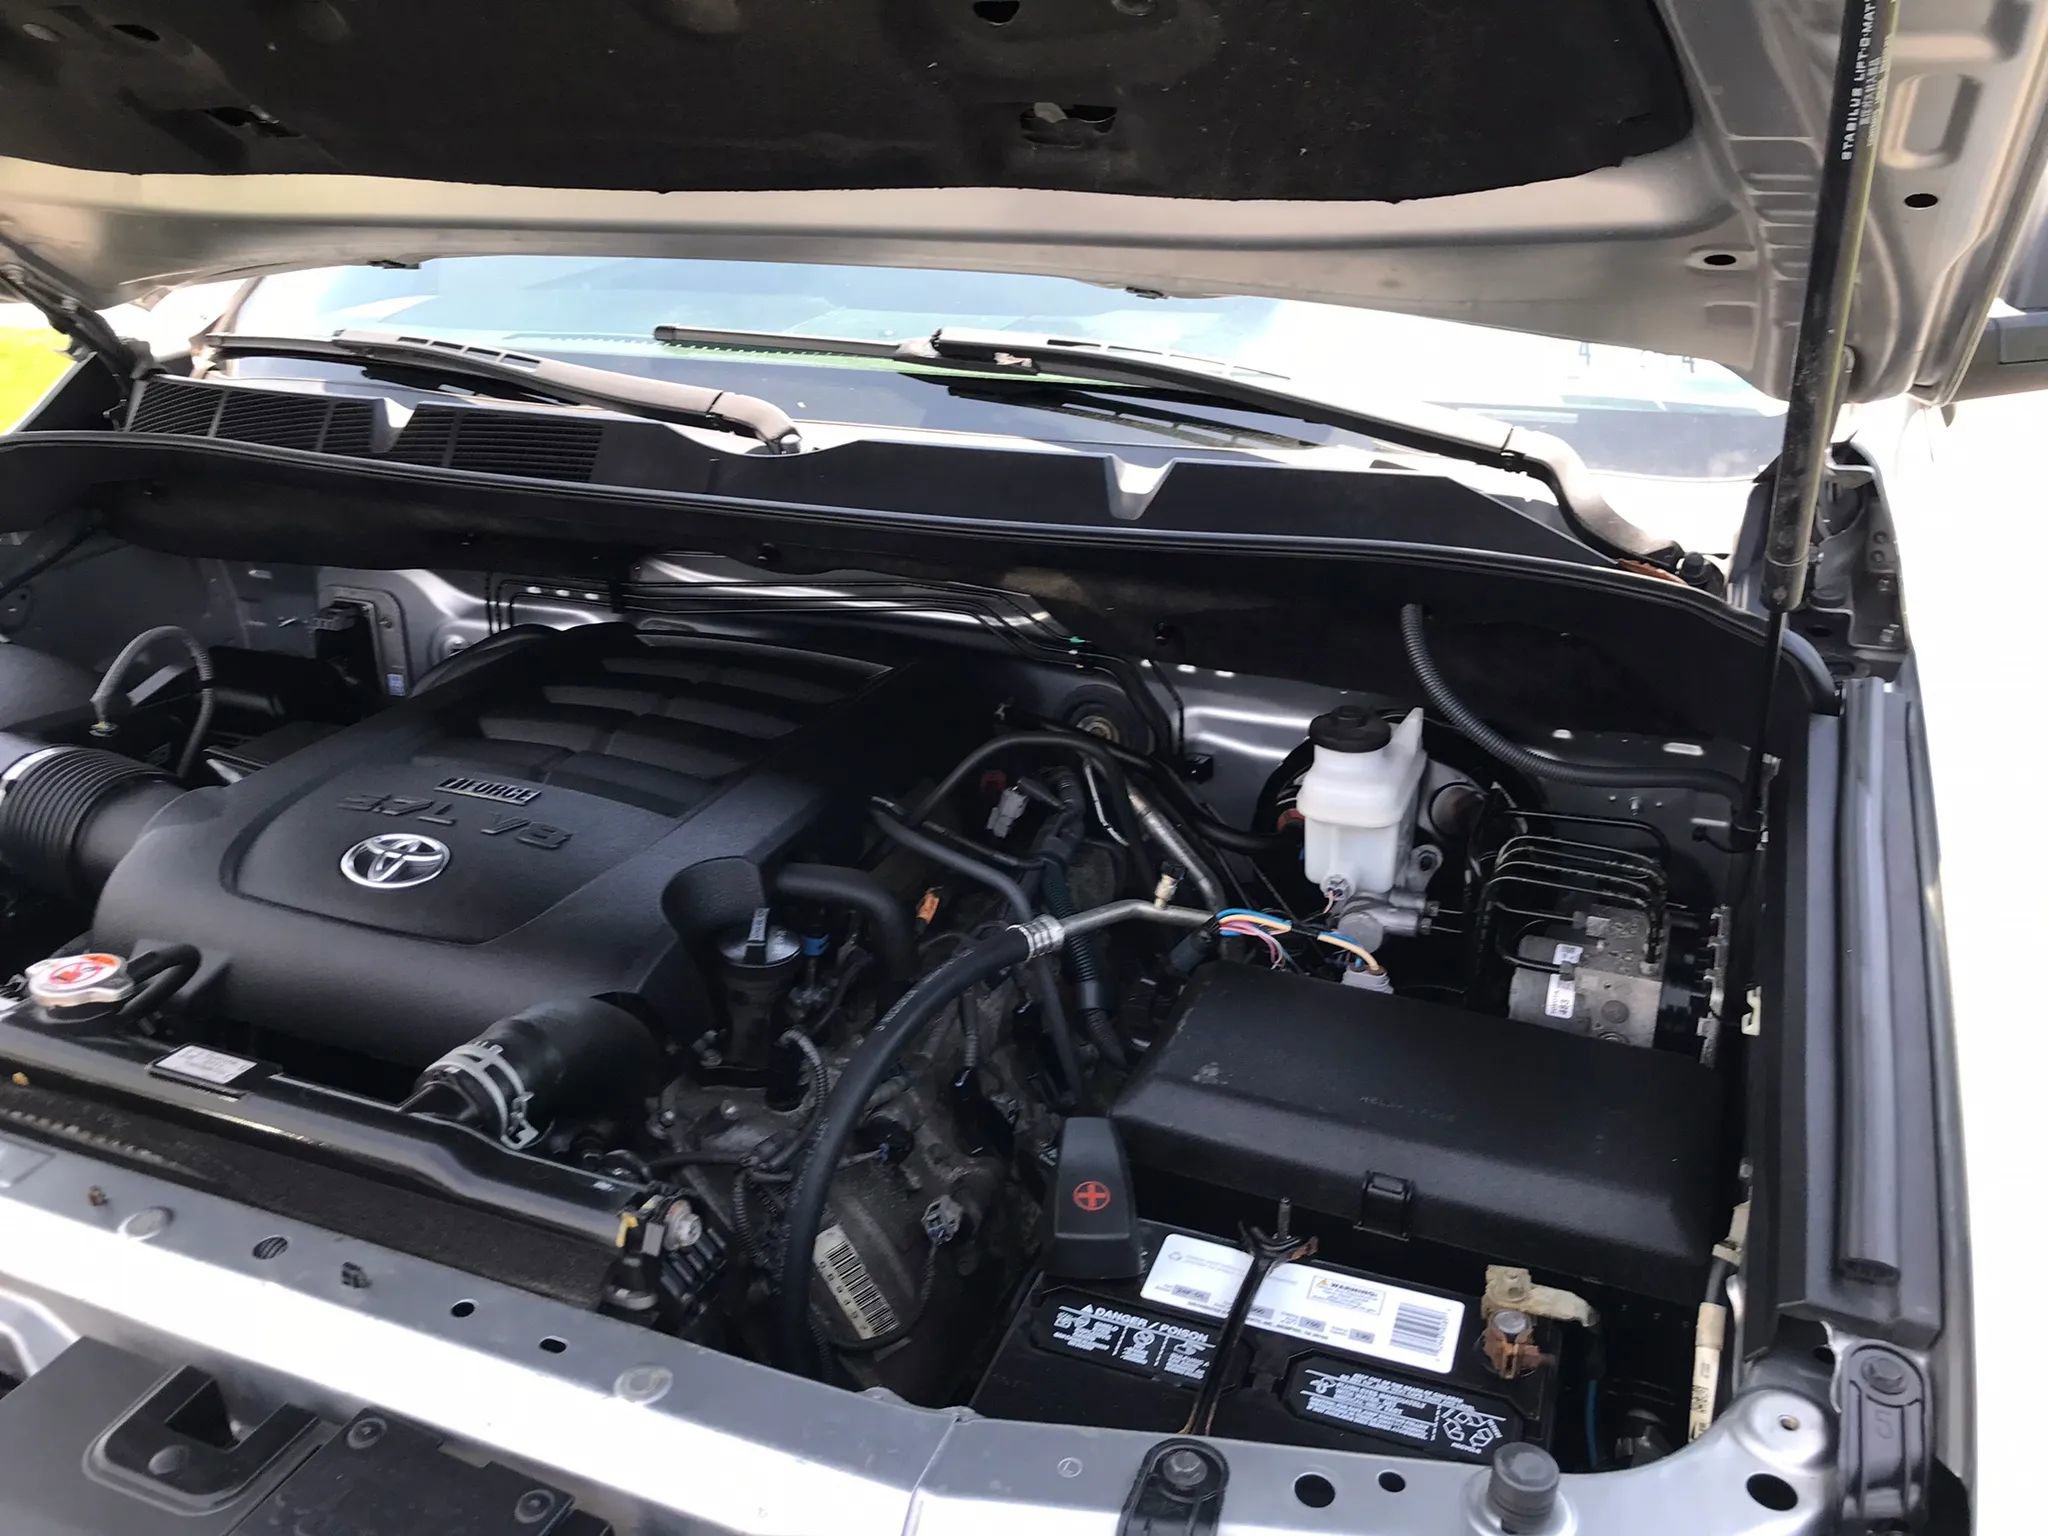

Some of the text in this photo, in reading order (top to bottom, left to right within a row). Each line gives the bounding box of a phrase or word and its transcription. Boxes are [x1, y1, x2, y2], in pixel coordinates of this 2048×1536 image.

[480, 811, 574, 849] V8
[1094, 1307, 1149, 1328] DANGER
[1159, 1324, 1209, 1342] POISON
